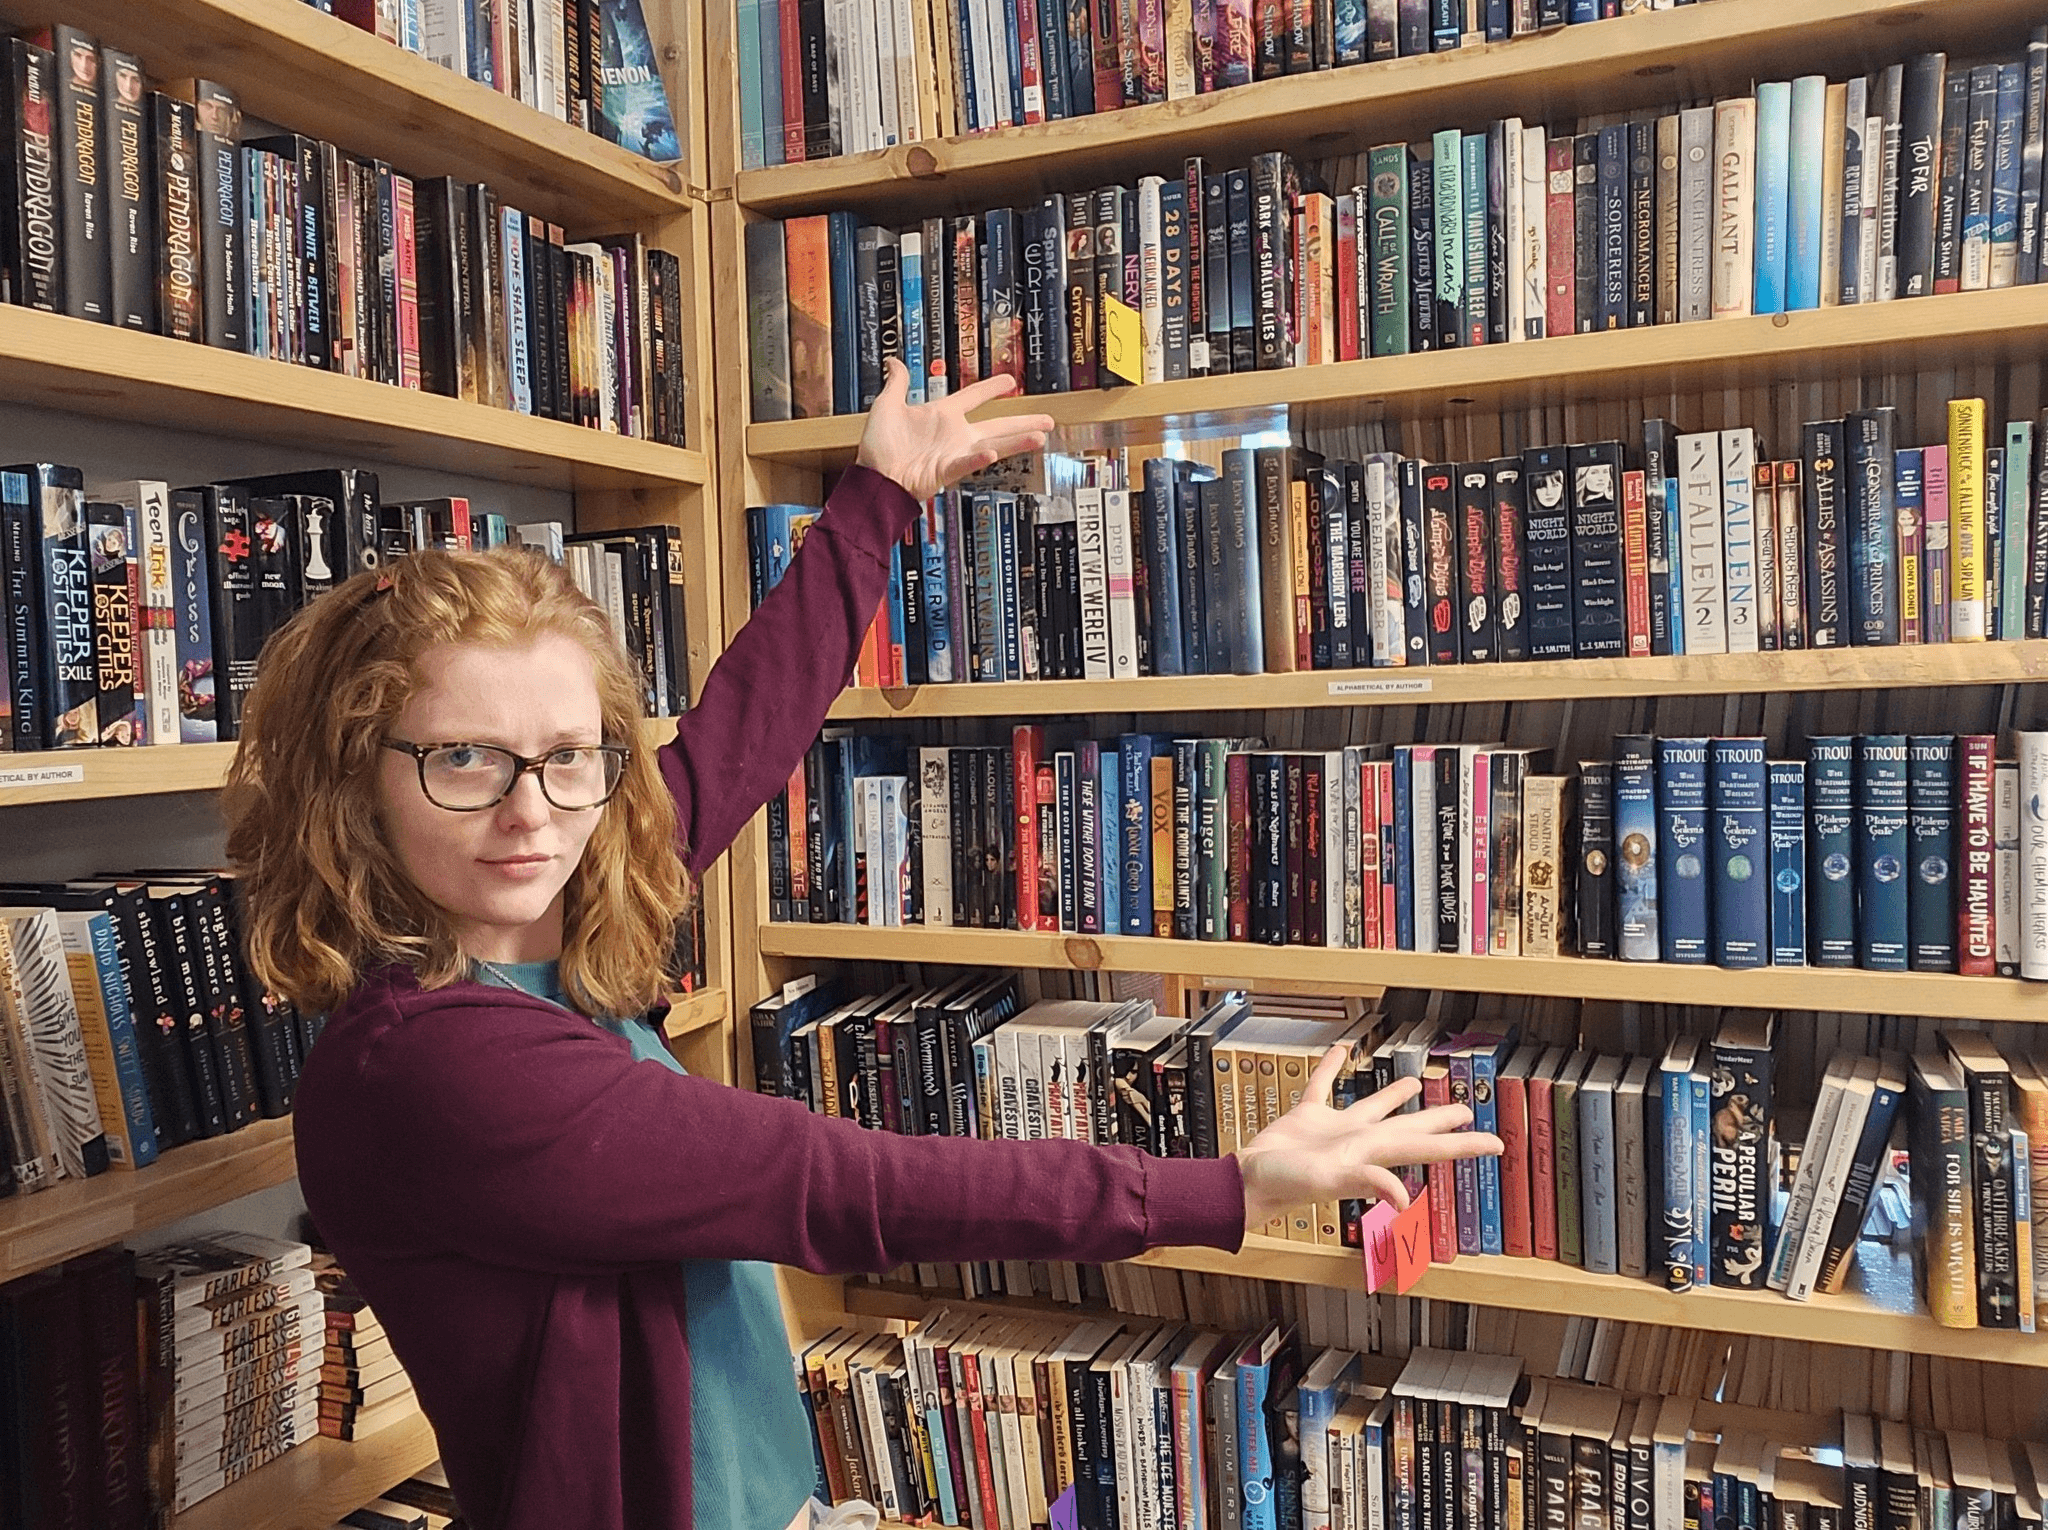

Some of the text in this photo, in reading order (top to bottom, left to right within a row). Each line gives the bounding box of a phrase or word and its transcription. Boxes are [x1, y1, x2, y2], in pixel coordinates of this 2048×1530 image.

[1264, 5, 1276, 58] SHADOW
[811, 61, 817, 72] OF
[75, 100, 95, 240] PENDRAGON Raven Rise
[217, 149, 234, 227] PENDRAGON
[1845, 165, 1860, 217] REVOLVER
[1909, 135, 1932, 198] TOO FAR
[25, 130, 54, 277] PENDRAGON
[403, 215, 412, 240] MISS
[1259, 196, 1271, 229] DARK
[1721, 152, 1740, 255] GALLANT
[1882, 174, 1900, 251] Mailbox
[167, 172, 191, 302] PENDRAGON
[224, 234, 232, 251] The
[303, 205, 317, 261] INFINITE
[404, 242, 413, 274] MATCH
[1044, 226, 1058, 279] Spark
[1165, 210, 1182, 307] 28 DAYS
[1608, 198, 1622, 303] SORCERESS
[1638, 189, 1650, 302] NECROMANCER
[1665, 200, 1678, 289] WARLOCK
[1692, 178, 1705, 296] ENCHANTRESS
[1941, 195, 1955, 276] ANTHEA SHARP
[1260, 252, 1274, 309] SHALLOW
[1375, 206, 1399, 315] CALL WRAITH
[1468, 210, 1486, 318] VANISHING DEEP
[226, 286, 232, 294] of
[308, 276, 320, 333] BETWEEN
[511, 236, 525, 386] NONE SHALL SLEEP
[960, 286, 974, 358] ERASED
[1109, 310, 1122, 362] S
[1262, 310, 1274, 340] LIES
[363, 493, 372, 536] the host
[1529, 518, 1564, 530] NIGHT
[1816, 474, 1835, 531] ALLIES
[145, 492, 165, 589] Teen Ink
[1004, 532, 1012, 554] THEY
[1110, 524, 1125, 566] prep
[1351, 520, 1364, 593] YOU ARE HERE
[1528, 528, 1568, 540] WORLD
[1725, 478, 1753, 625] FALLEN 3
[1866, 463, 1883, 615] CONSPIRACY PRINCES
[1078, 503, 1106, 664] FIRST WE WERE IV
[1330, 521, 1347, 628] THE MARBURY LENS
[1372, 501, 1385, 630] DREAMSTRIDER
[1818, 542, 1838, 623] ASSASSINS
[51, 548, 72, 665] LOST CITIES
[67, 550, 91, 663] KEEPER
[925, 556, 946, 651] EVERWILD
[1007, 607, 1014, 618] AT
[59, 666, 93, 681] EXILE
[1546, 645, 1570, 653] SMITH
[1396, 682, 1423, 690] AUTHOR
[28, 770, 73, 781] BY AUTHOR
[1663, 749, 1709, 763] STROUD
[1715, 749, 1763, 763] STROUD
[1770, 773, 1804, 783] STROUD
[1969, 755, 1984, 770] IF
[1082, 779, 1093, 807] THESE
[1153, 790, 1170, 833] VOX
[1968, 781, 1990, 823] HAVE
[772, 802, 783, 896] STAR CURSED
[1082, 809, 1094, 845] WITCHES
[1176, 786, 1190, 909] ALL THE CROOKED SAINTS
[1200, 798, 1219, 858] linger
[1530, 813, 1538, 850] STROUD
[1541, 808, 1552, 859] JONATHAN
[1969, 827, 1990, 847] TO
[1970, 851, 1990, 874] BE
[1084, 877, 1095, 908] BURN
[1540, 896, 1549, 940] AMULET
[1968, 879, 1991, 957] HAUNTED
[137, 910, 168, 1006] shadowland
[173, 916, 197, 1007] blue moon
[199, 916, 220, 995] evermore
[213, 906, 234, 984] night star
[53, 990, 70, 1005] I'LL
[95, 929, 125, 1030] DAVID NICHOLLS
[57, 1010, 77, 1027] GIVE
[61, 1030, 80, 1046] YOU
[68, 1053, 84, 1067] THE
[71, 1072, 88, 1086] SUN
[919, 1028, 939, 1097] Wormwood
[1716, 1054, 1753, 1064] VanderMeer
[1097, 1100, 1109, 1137] SPIRIT
[1221, 1084, 1235, 1135] ORACLE
[1712, 1147, 1737, 1215] PERIL
[1739, 1147, 1756, 1221] PECULIAR
[1946, 1153, 1961, 1184] FOR
[1947, 1187, 1962, 1218] SHE
[1372, 1225, 1388, 1265] U
[1401, 1220, 1418, 1265] V
[205, 1262, 272, 1301] FEARLESS
[211, 1287, 277, 1327] FEARLESS
[1422, 1447, 1431, 1508] SEARCH FOR
[1444, 1452, 1453, 1495] CONFLICT
